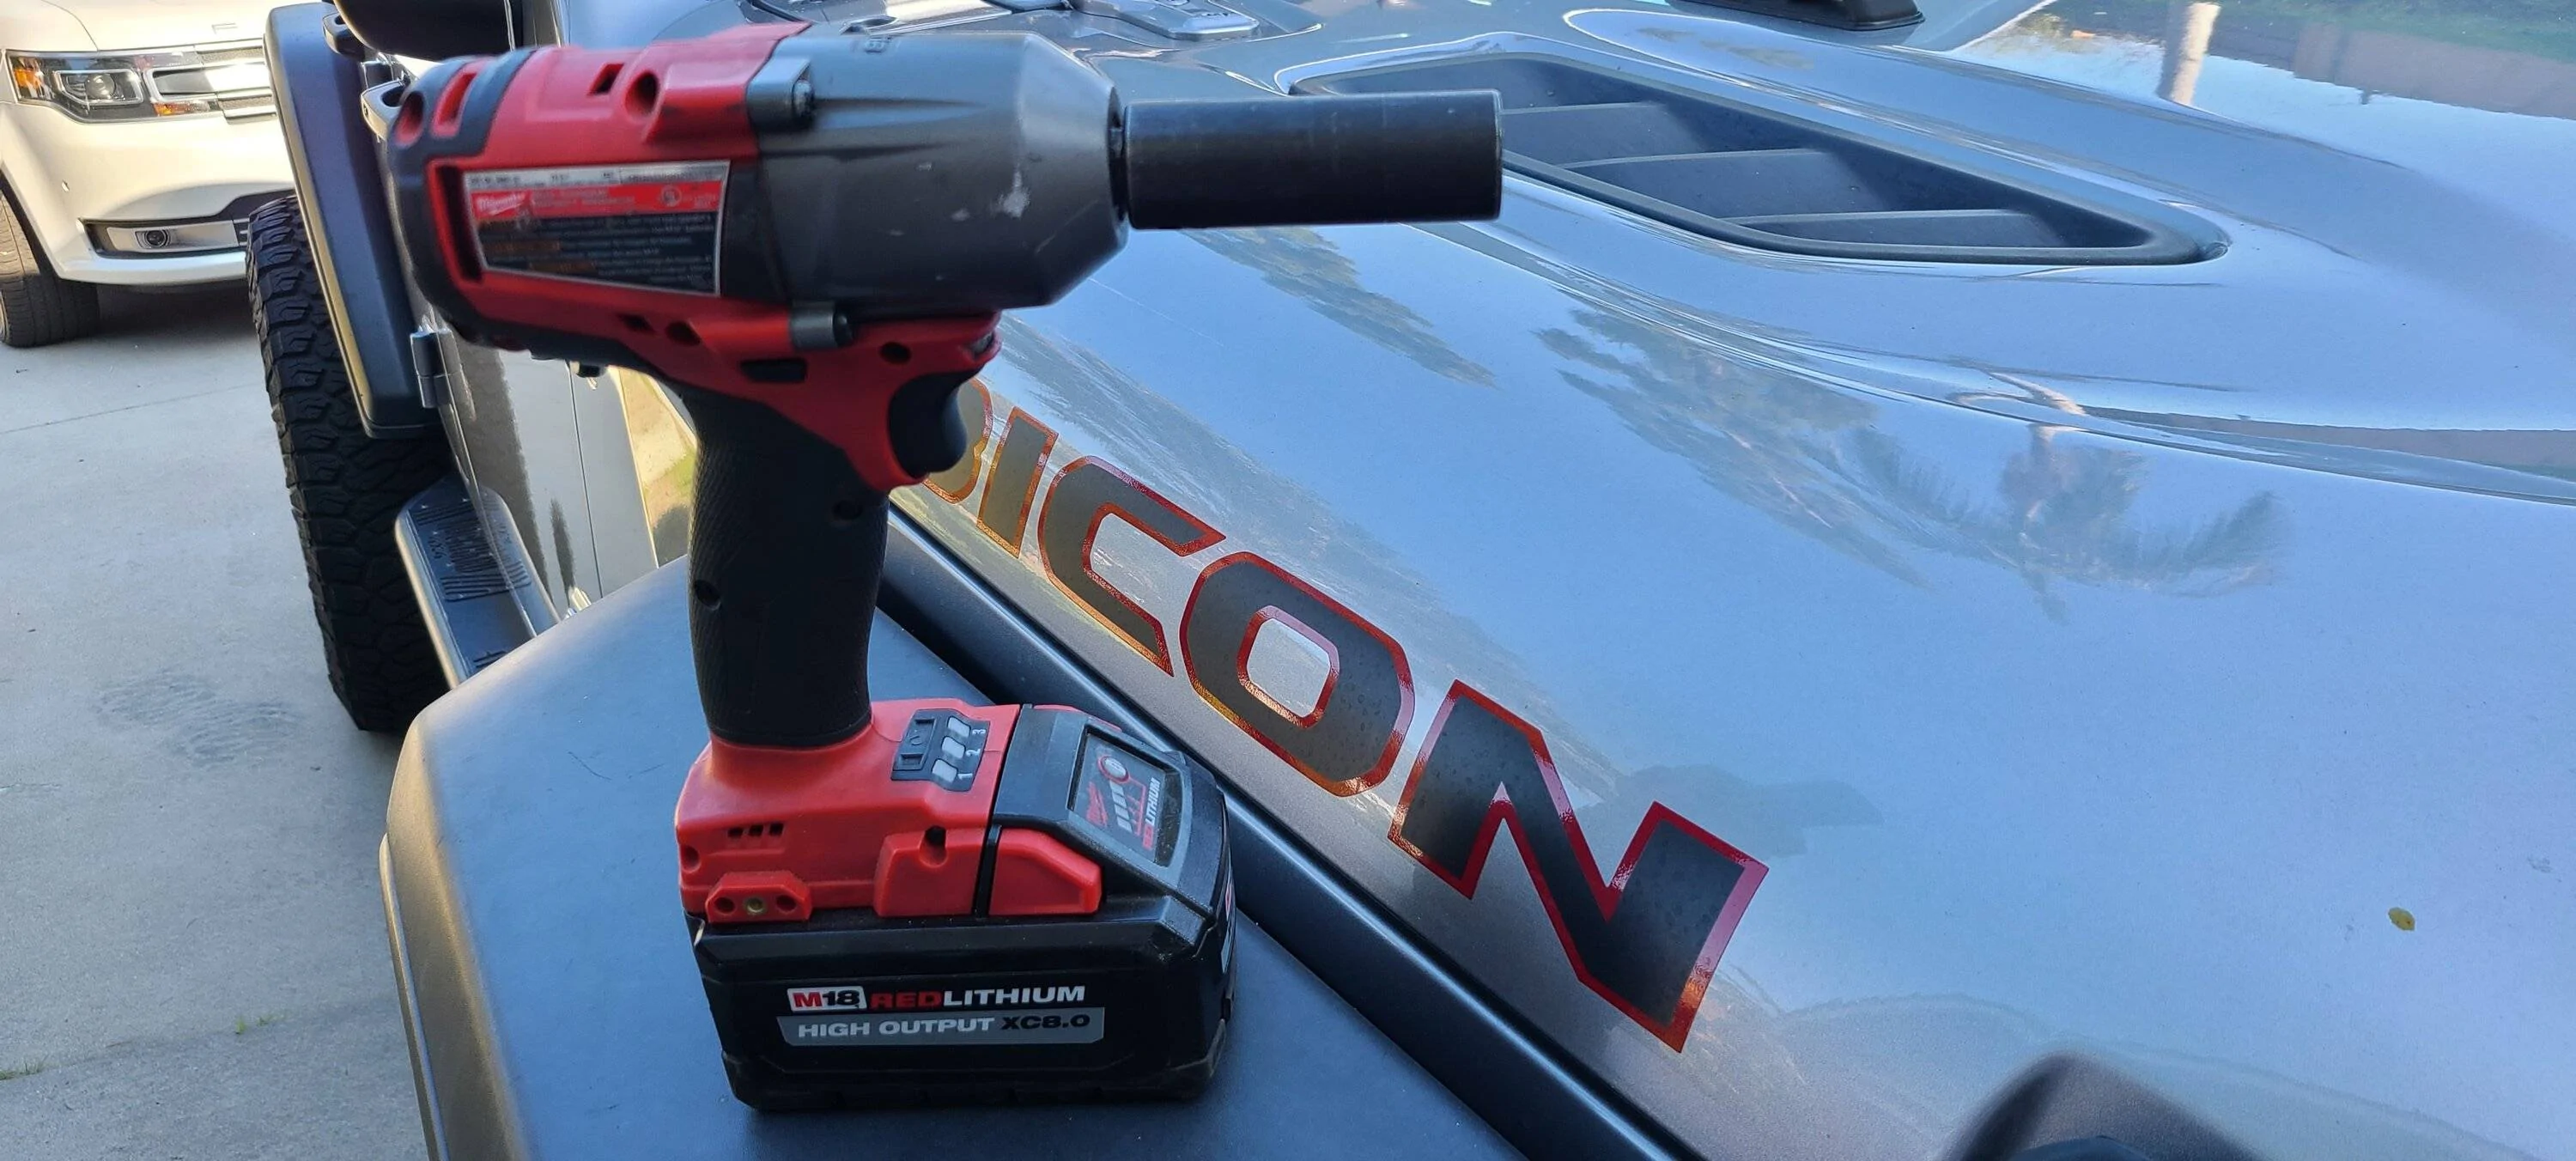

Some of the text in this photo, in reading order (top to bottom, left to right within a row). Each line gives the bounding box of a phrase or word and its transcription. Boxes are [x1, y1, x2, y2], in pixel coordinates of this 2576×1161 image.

[965, 748, 981, 757] 2
[793, 986, 1085, 1010] M18 REDLITHIUM
[798, 1013, 1091, 1038] HIGH OUTPUT XC8.0
